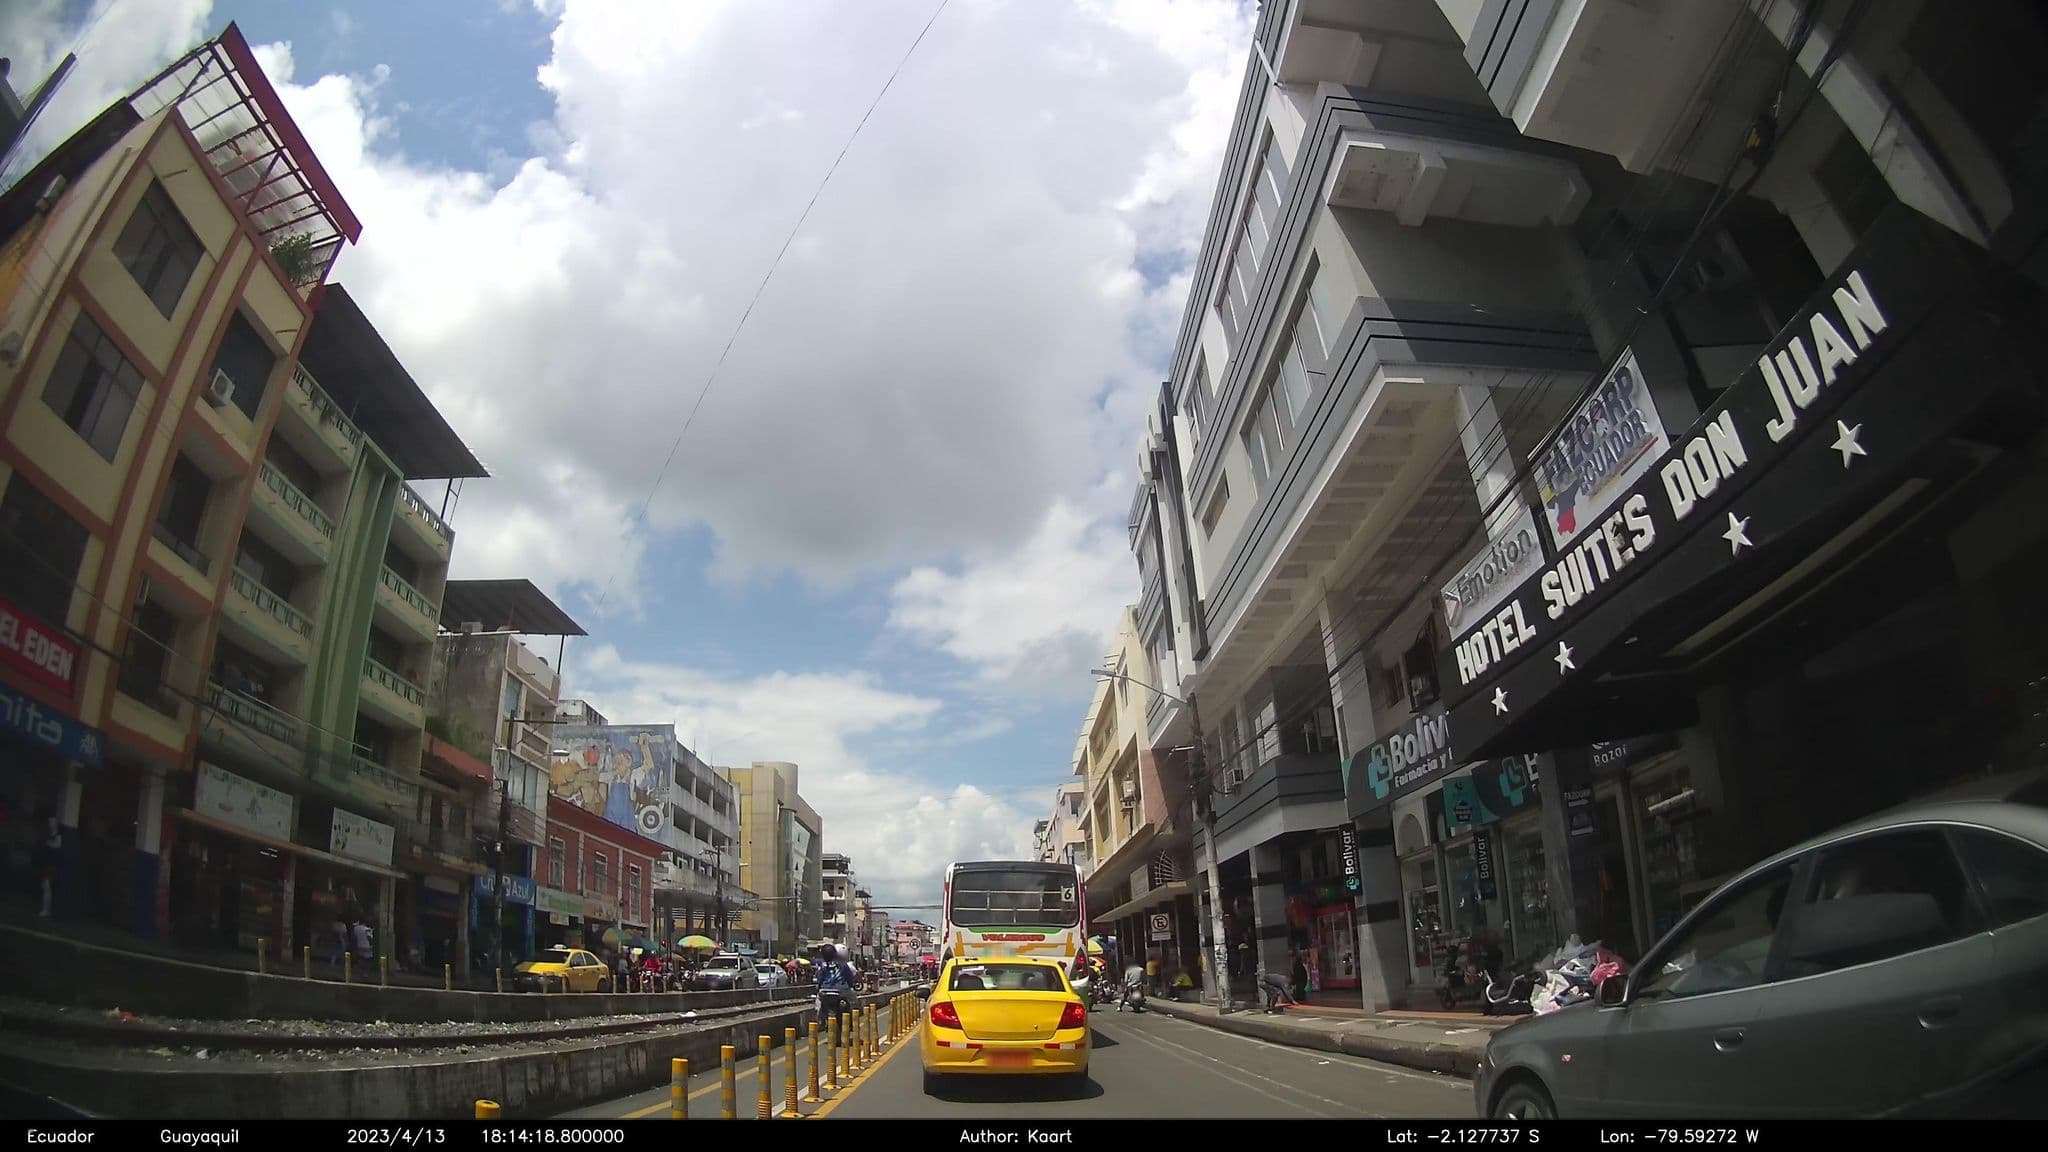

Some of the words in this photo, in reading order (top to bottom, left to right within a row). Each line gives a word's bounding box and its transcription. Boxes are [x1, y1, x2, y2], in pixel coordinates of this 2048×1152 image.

[1543, 366, 1634, 490] FAZCORP
[1579, 408, 1646, 496] ECUADOR
[1454, 605, 1537, 685] HOTEL
[1540, 493, 1657, 622] SUITES
[1660, 410, 1749, 521] DON
[1757, 269, 1889, 444] JUAN
[1458, 527, 1533, 604] Emotion
[22, 628, 74, 681] EDEN
[1389, 712, 1450, 773] Boliv
[1394, 757, 1440, 787] Farmacia
[1342, 831, 1355, 875] Bolivar
[1478, 838, 1490, 879] Bolivar
[1063, 889, 1072, 900] 6
